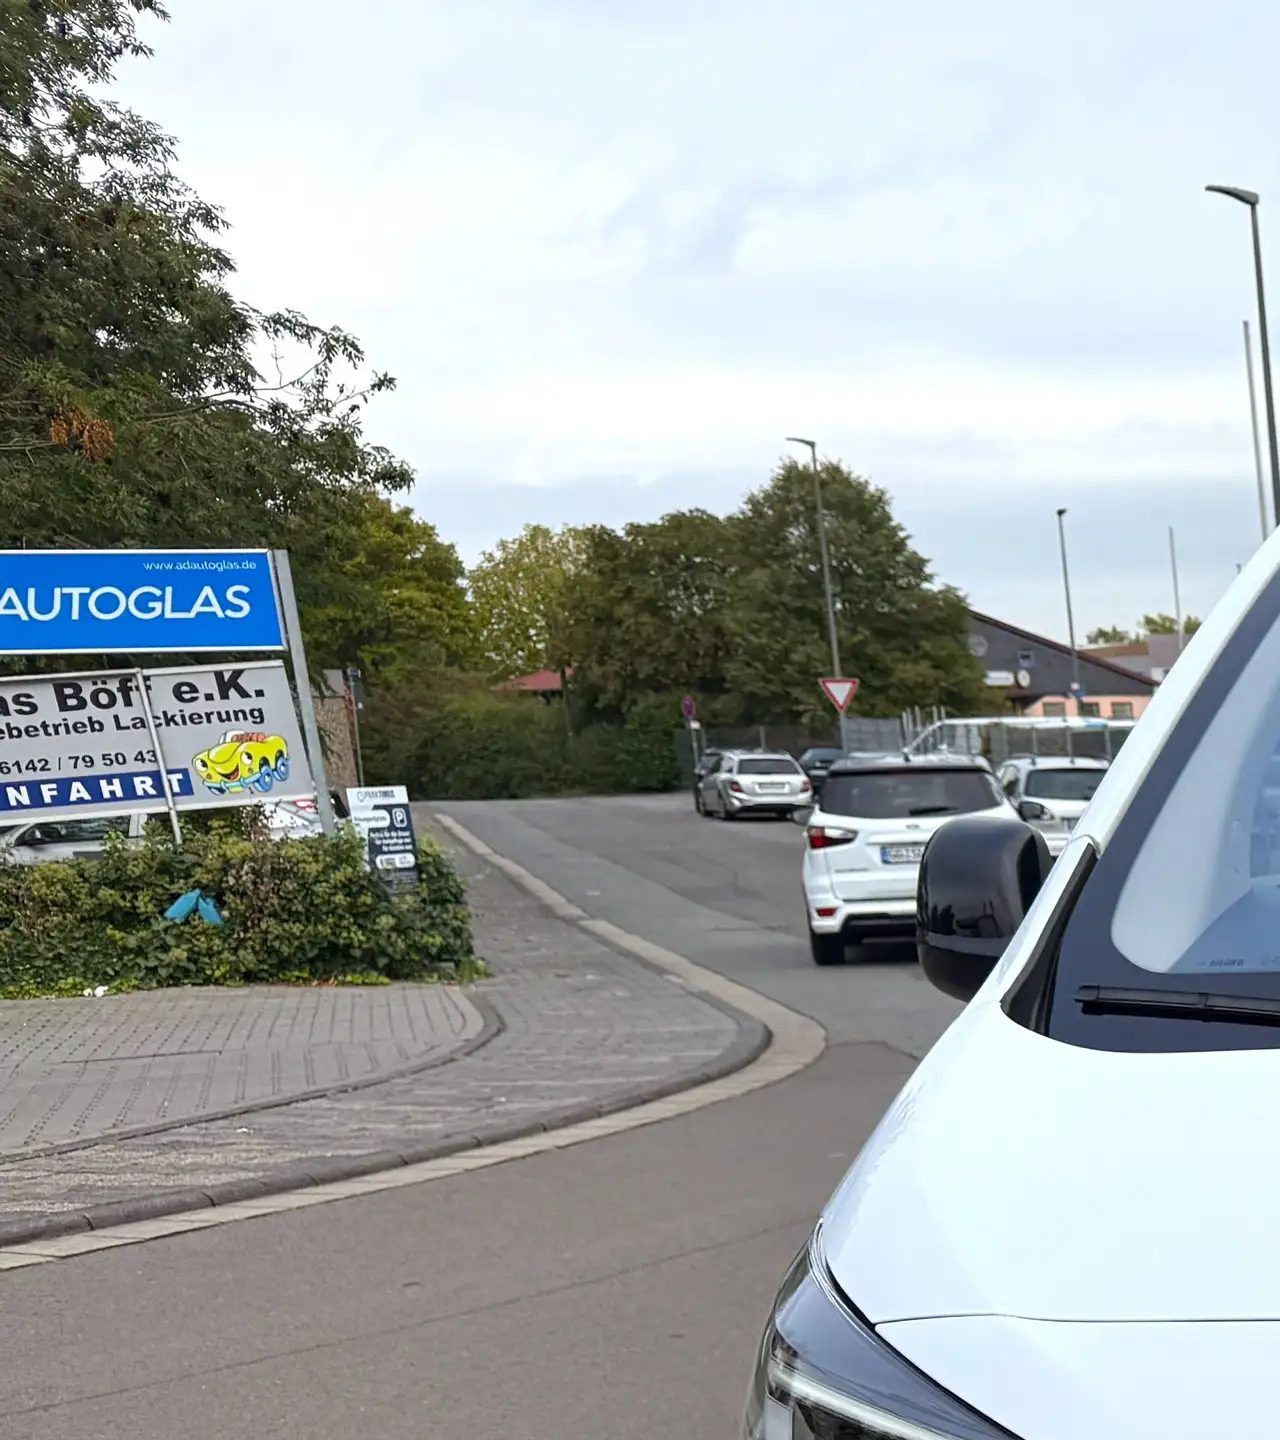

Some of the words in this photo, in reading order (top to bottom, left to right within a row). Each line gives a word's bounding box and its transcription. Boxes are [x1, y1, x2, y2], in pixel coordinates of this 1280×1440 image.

[142, 560, 257, 572] www.adautoglas.de
[0, 584, 250, 621] AUTOGLAS
[172, 669, 265, 703] e.K.
[69, 754, 95, 770] 79
[102, 751, 127, 767] 50
[133, 749, 157, 764] 43
